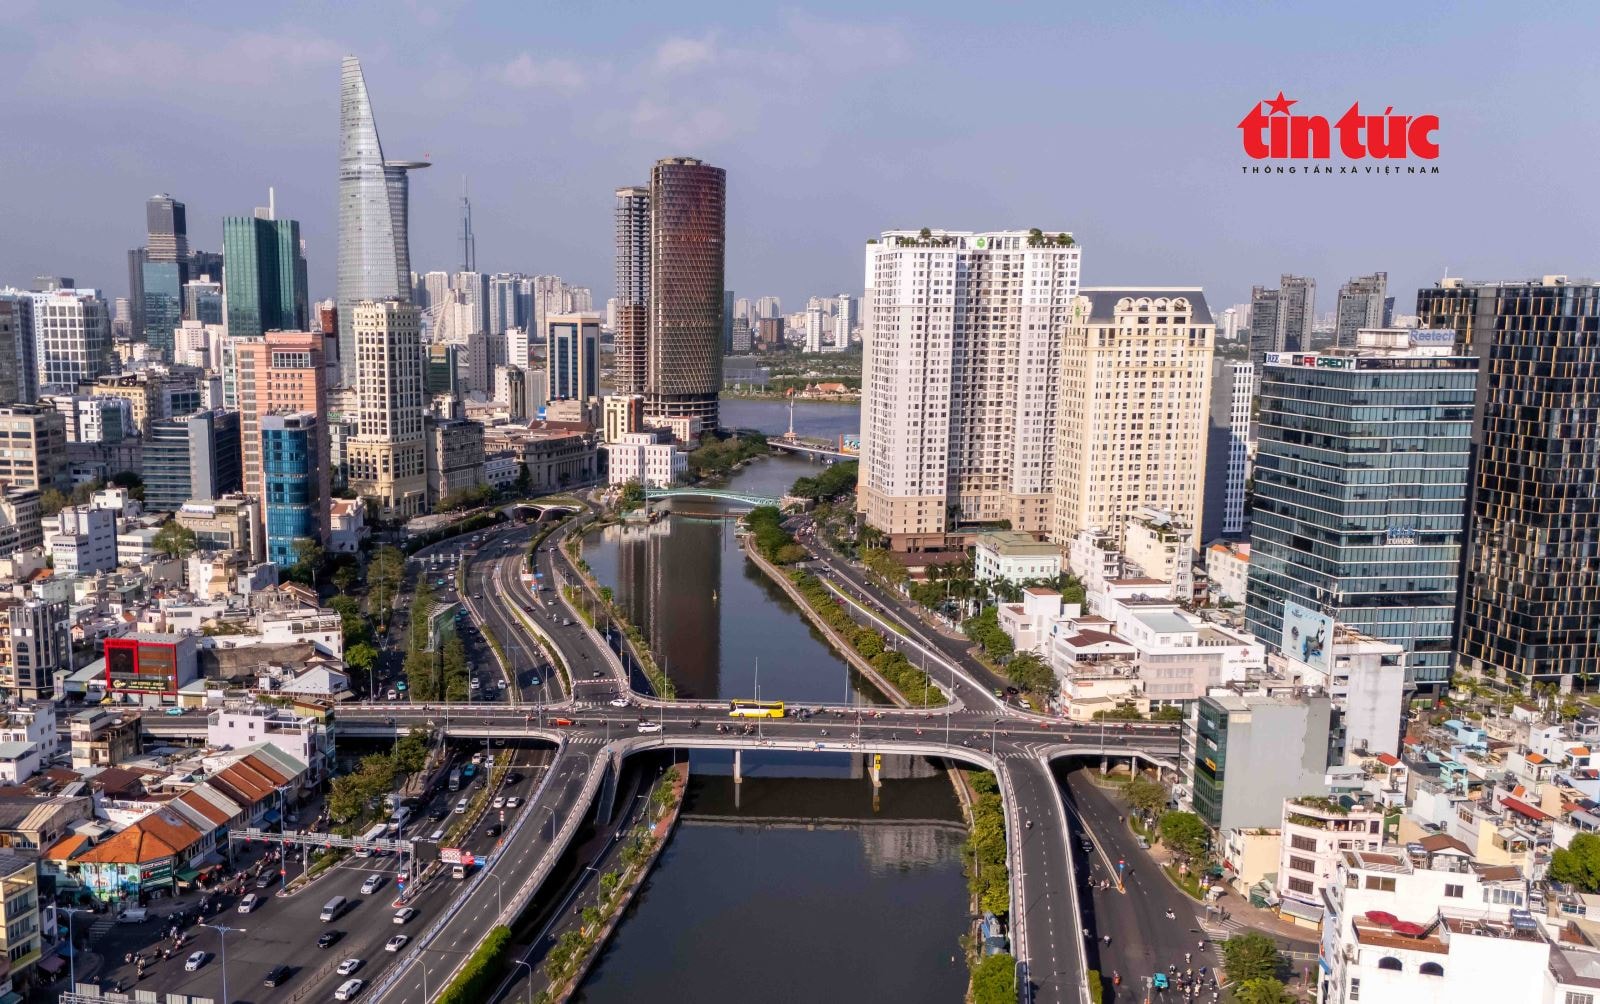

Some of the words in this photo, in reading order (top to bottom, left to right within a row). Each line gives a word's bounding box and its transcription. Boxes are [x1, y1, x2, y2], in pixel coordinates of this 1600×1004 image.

[1410, 330, 1455, 341] Reetech
[1303, 356, 1315, 366] FE
[1317, 357, 1353, 369] CREDIT
